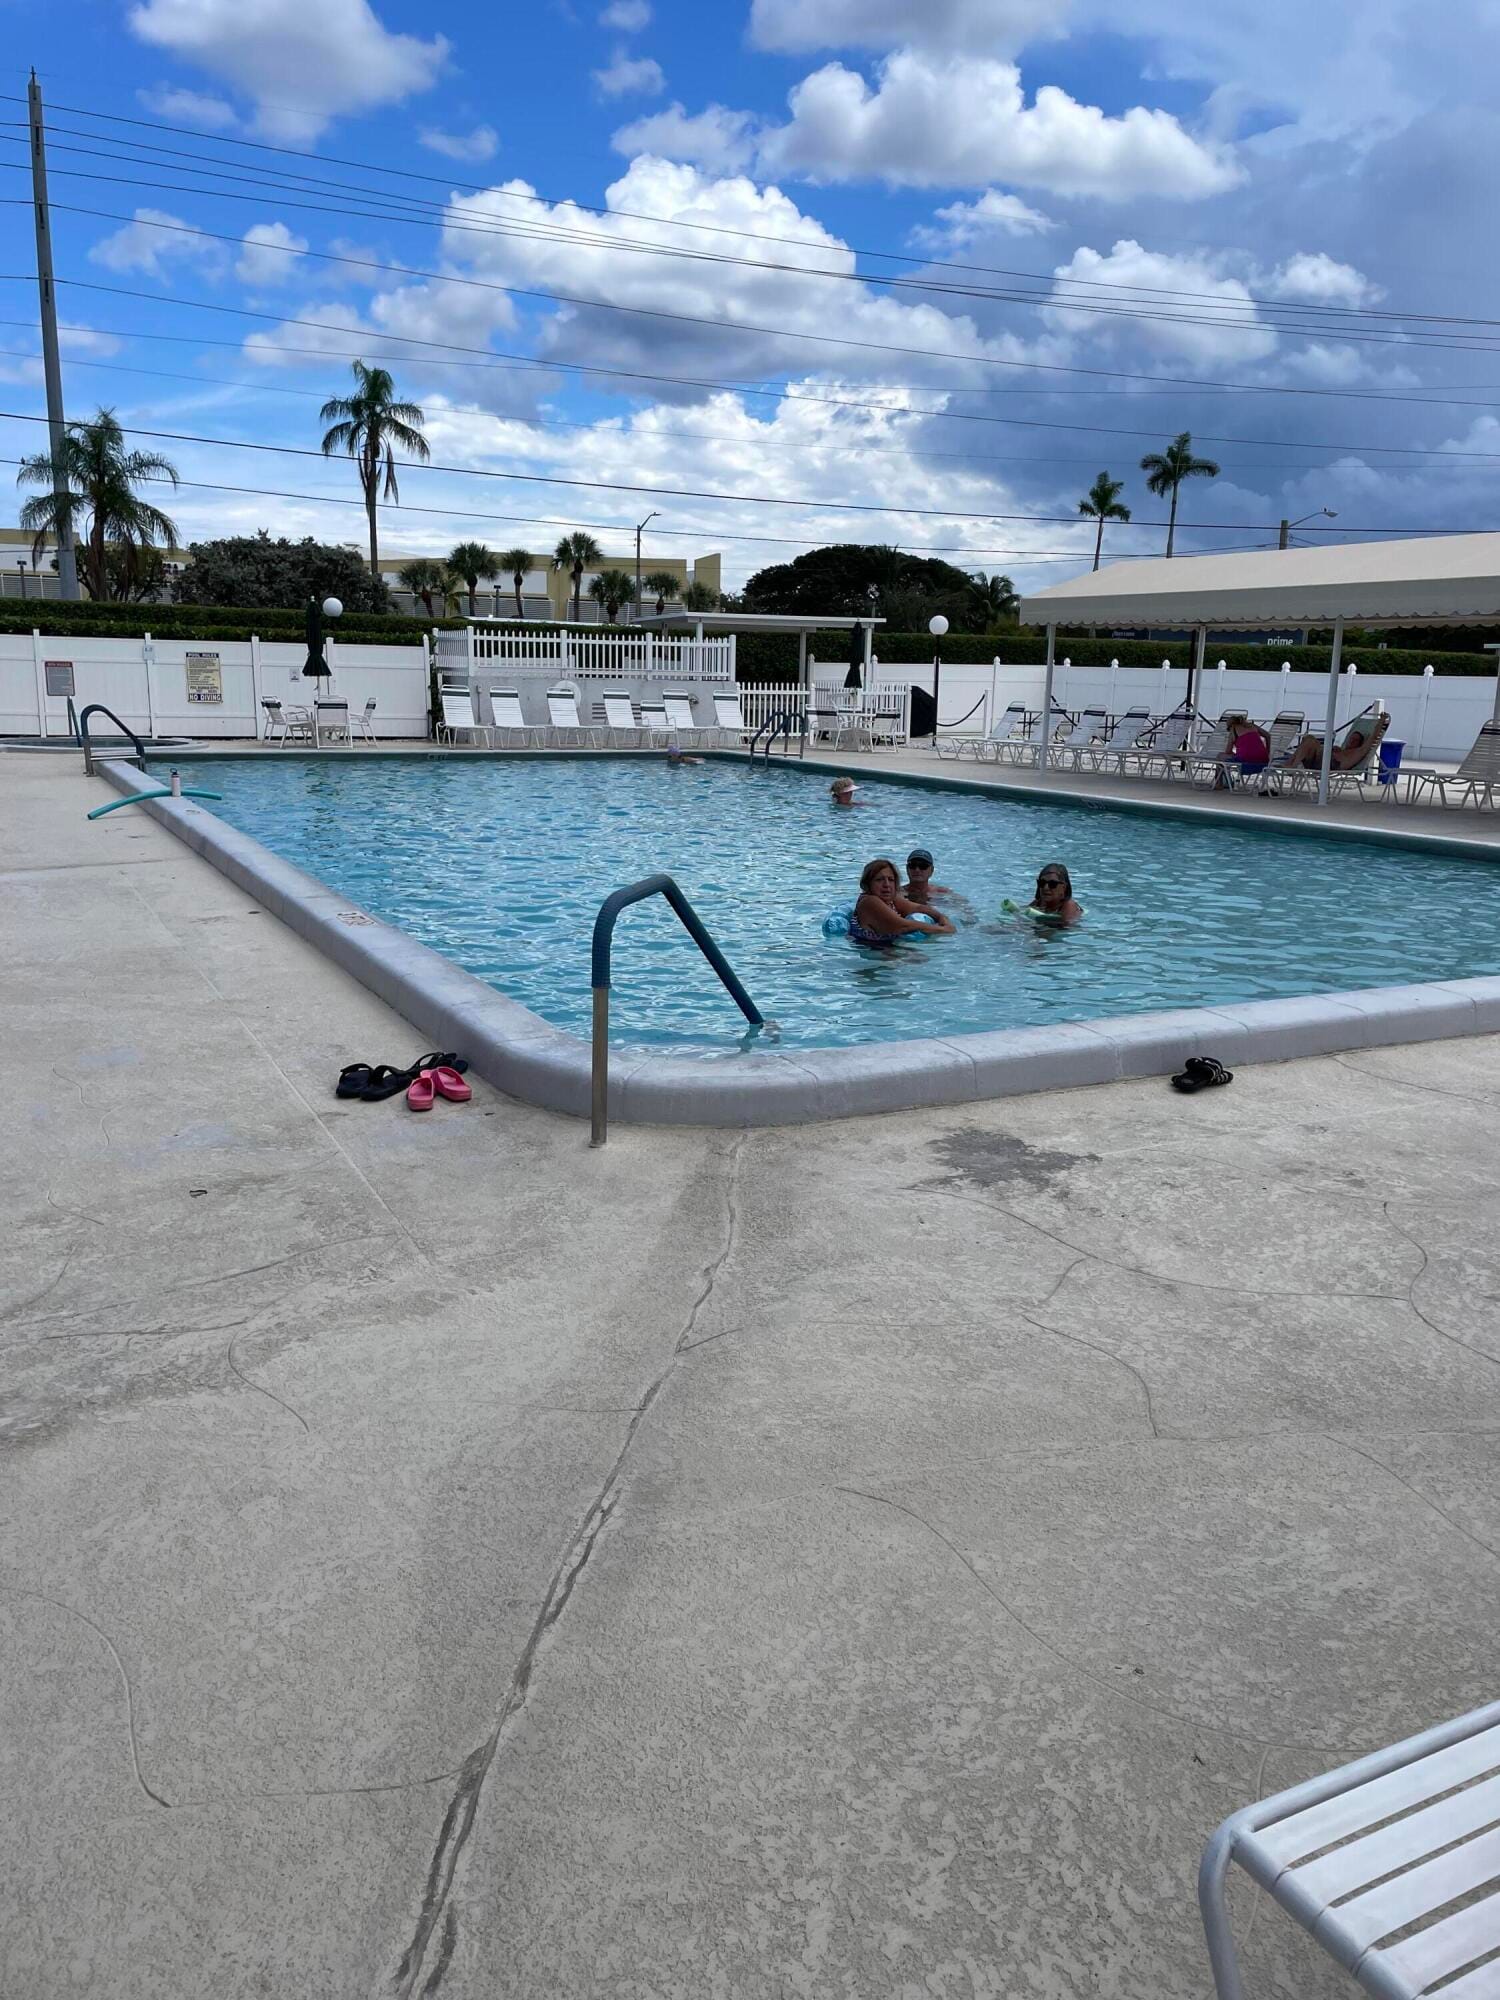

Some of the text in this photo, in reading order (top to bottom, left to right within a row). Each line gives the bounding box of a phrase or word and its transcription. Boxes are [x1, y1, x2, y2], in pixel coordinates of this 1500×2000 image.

[1267, 635, 1294, 646] prime
[189, 693, 221, 701] NO DIVING
